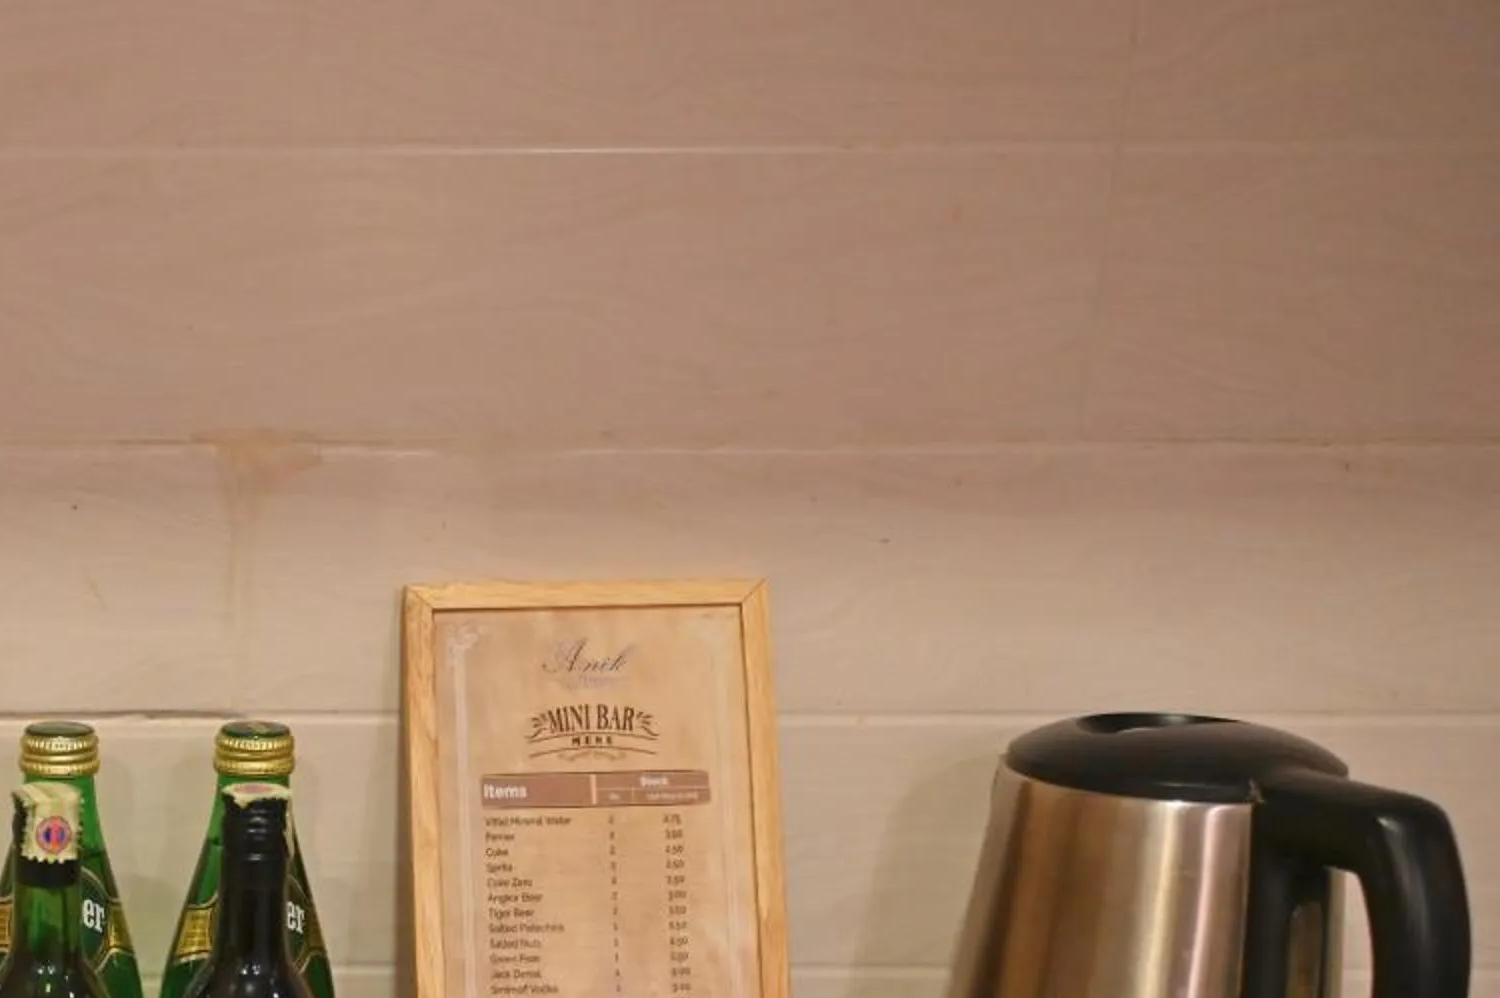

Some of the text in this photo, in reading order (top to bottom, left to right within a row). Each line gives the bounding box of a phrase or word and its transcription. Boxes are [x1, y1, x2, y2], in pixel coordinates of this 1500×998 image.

[548, 703, 634, 732] MINI BAR
[483, 783, 527, 799] Items
